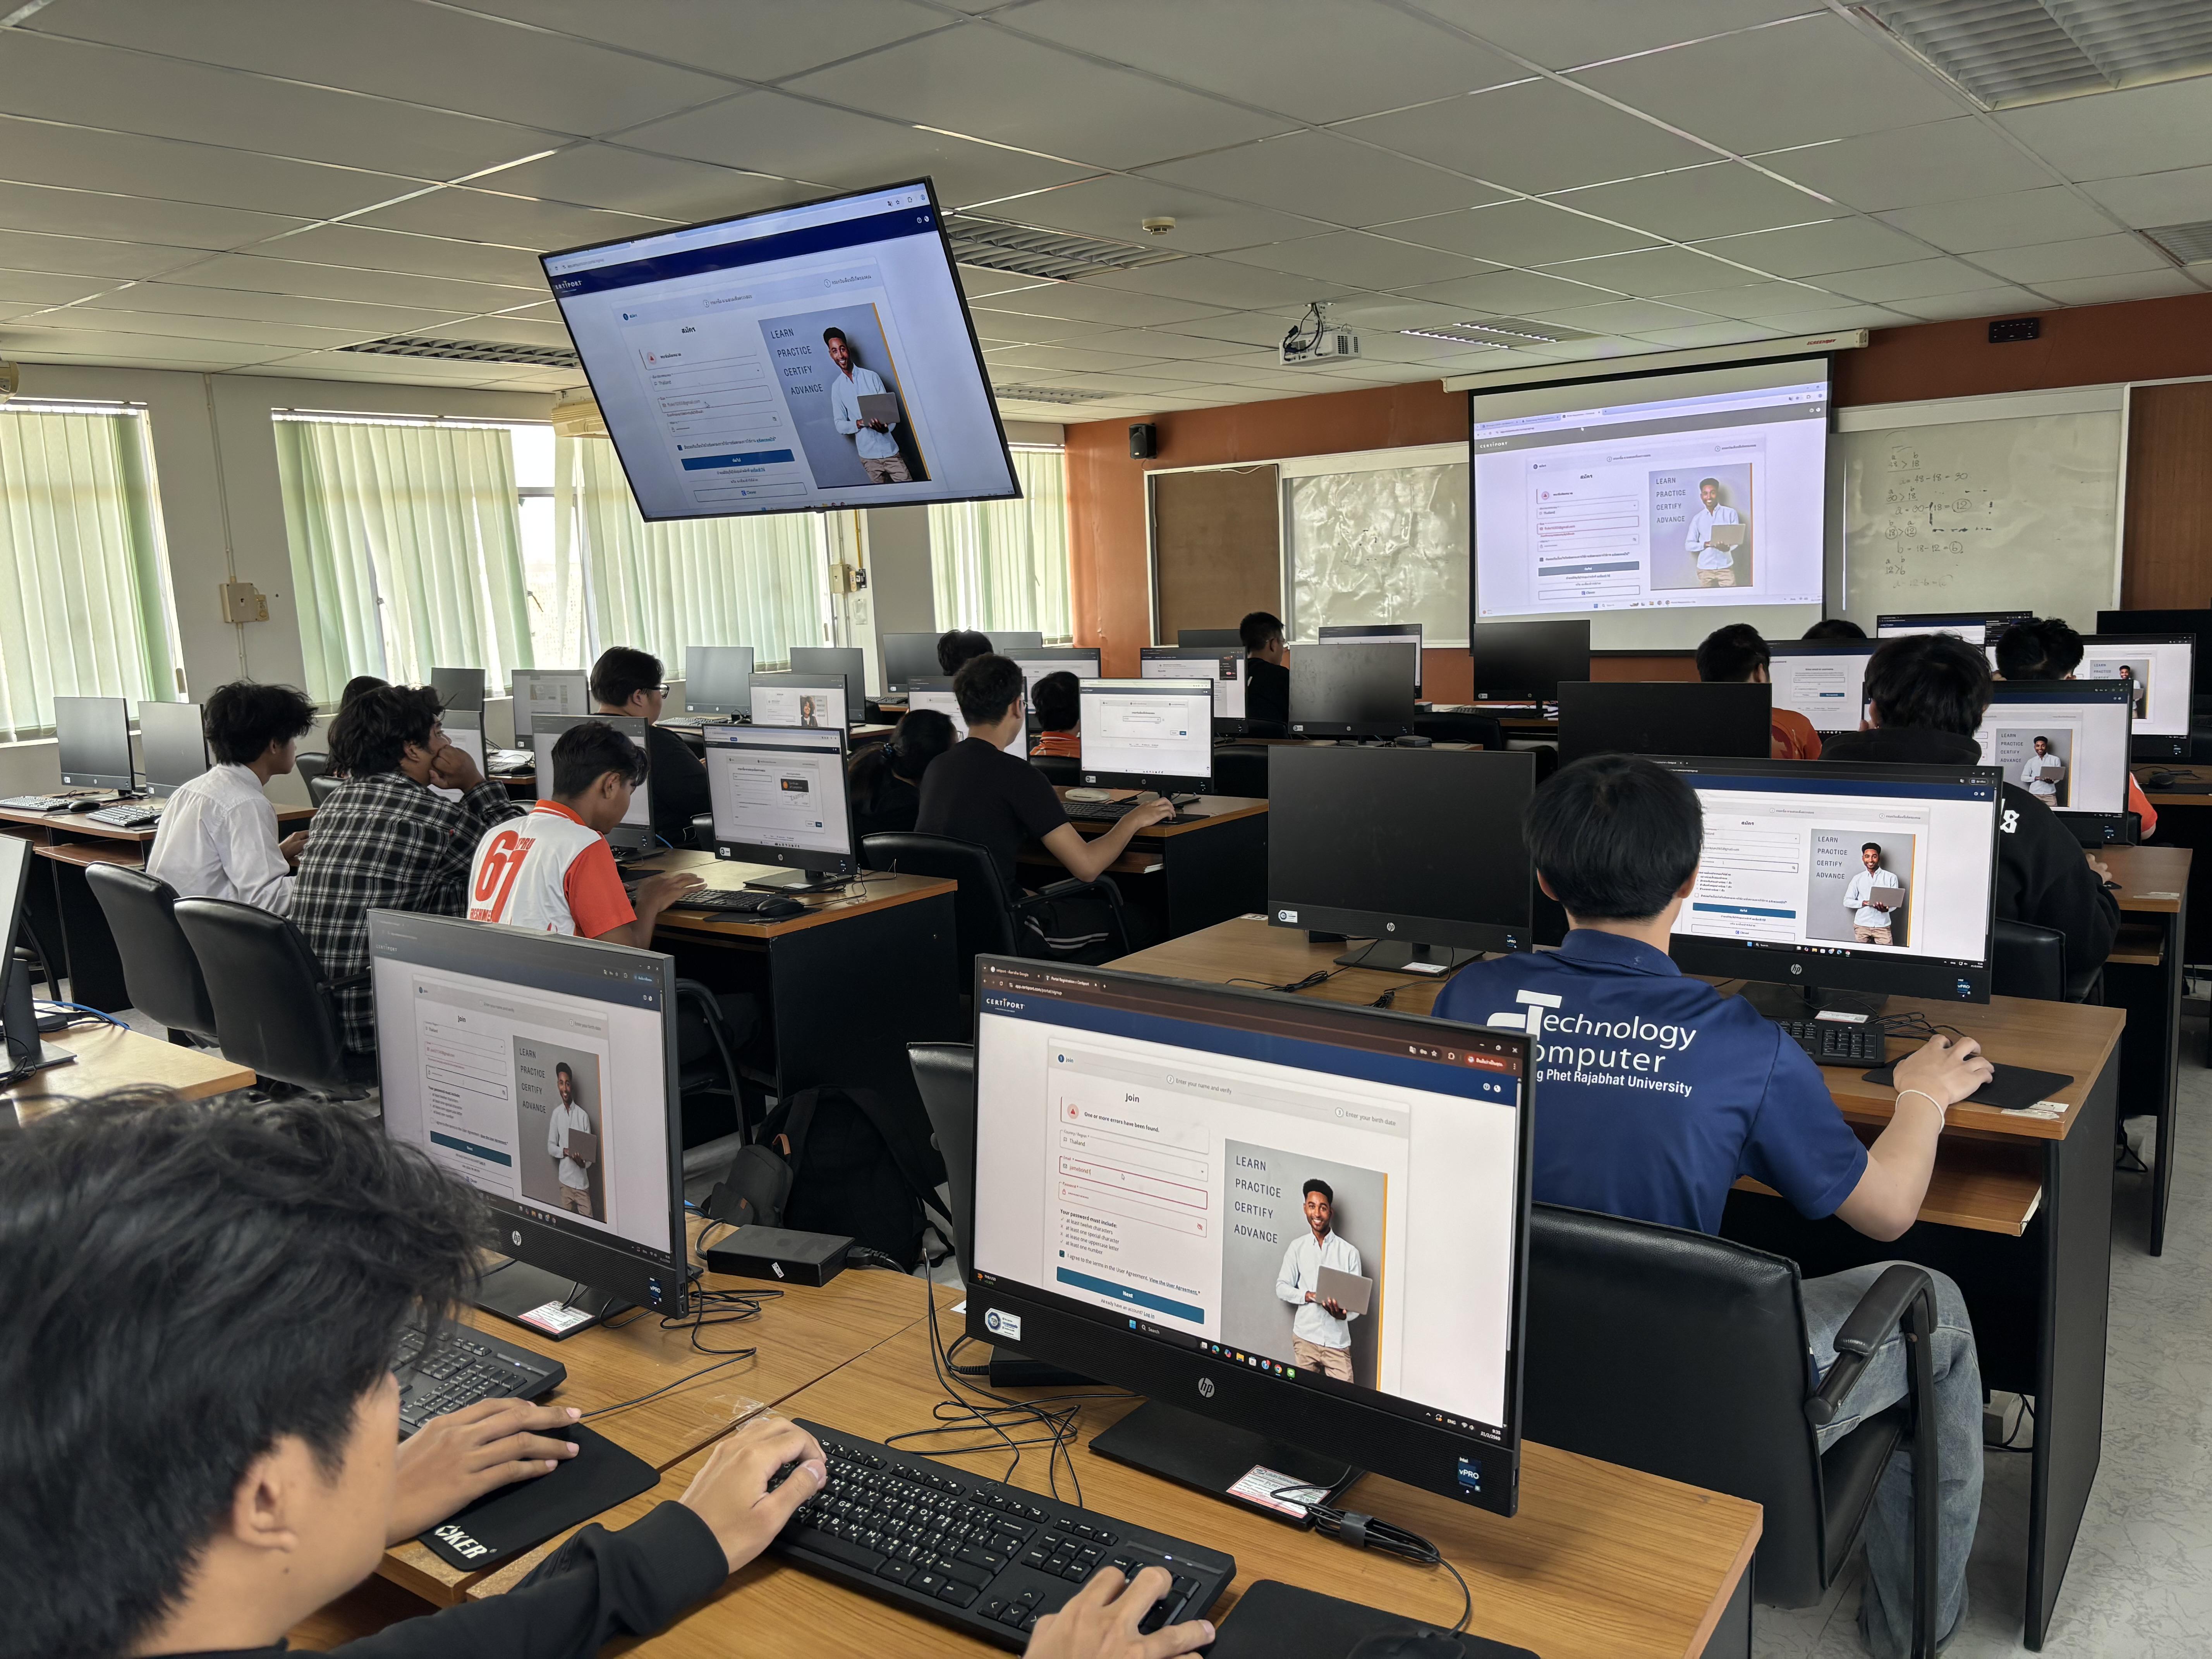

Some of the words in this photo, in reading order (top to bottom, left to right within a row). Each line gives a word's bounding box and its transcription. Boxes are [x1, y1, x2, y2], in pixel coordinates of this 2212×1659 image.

[554, 281, 582, 290] ERTIPORT
[682, 325, 696, 334] สมัคร
[771, 328, 794, 339] LEARN
[777, 346, 812, 357] PRACTICE
[784, 366, 812, 376] CERTIFY
[791, 384, 823, 395] ADVANCE
[1792, 964, 1801, 975] hp
[986, 998, 1025, 1010] CERTIPORT
[1516, 989, 1697, 1051] Technology
[519, 1047, 536, 1059] LEARN
[1536, 1044, 1666, 1072] omputer
[520, 1065, 545, 1078] PRACTICE
[1546, 1068, 1571, 1082] Phet
[1574, 1071, 1625, 1086] Rajabhat
[1628, 1075, 1692, 1097] University
[522, 1083, 542, 1095] CERTIFY
[1220, 1087, 1232, 1095] verify
[1125, 1092, 1140, 1103] Join
[523, 1100, 546, 1114] ADVANCE
[1346, 1110, 1358, 1119] Enter
[1360, 1114, 1370, 1122] your
[1372, 1115, 1384, 1124] birth
[1384, 1118, 1396, 1126] date
[1146, 1123, 1160, 1133] found.
[1070, 1138, 1085, 1146] Thailand
[1236, 1155, 1266, 1171] LEARN
[1236, 1178, 1281, 1198] PRACTICE
[1235, 1201, 1273, 1219] CERTIFY
[1070, 1212, 1089, 1220] password
[1101, 1220, 1117, 1228] include:
[1093, 1225, 1113, 1235] characters
[1234, 1224, 1278, 1244] ADVANCE
[513, 1231, 521, 1245] hp
[1101, 1235, 1119, 1244] character
[1089, 1239, 1108, 1249] uppercase
[1088, 1247, 1103, 1255] number
[1126, 1270, 1149, 1281] Agreement.
[1123, 1290, 1133, 1298] Next
[1101, 1298, 1114, 1307] Already
[1128, 1306, 1143, 1315] account?
[1148, 1326, 1160, 1335] Search
[1198, 1377, 1215, 1398] hp
[1459, 1469, 1479, 1479] vPRO
